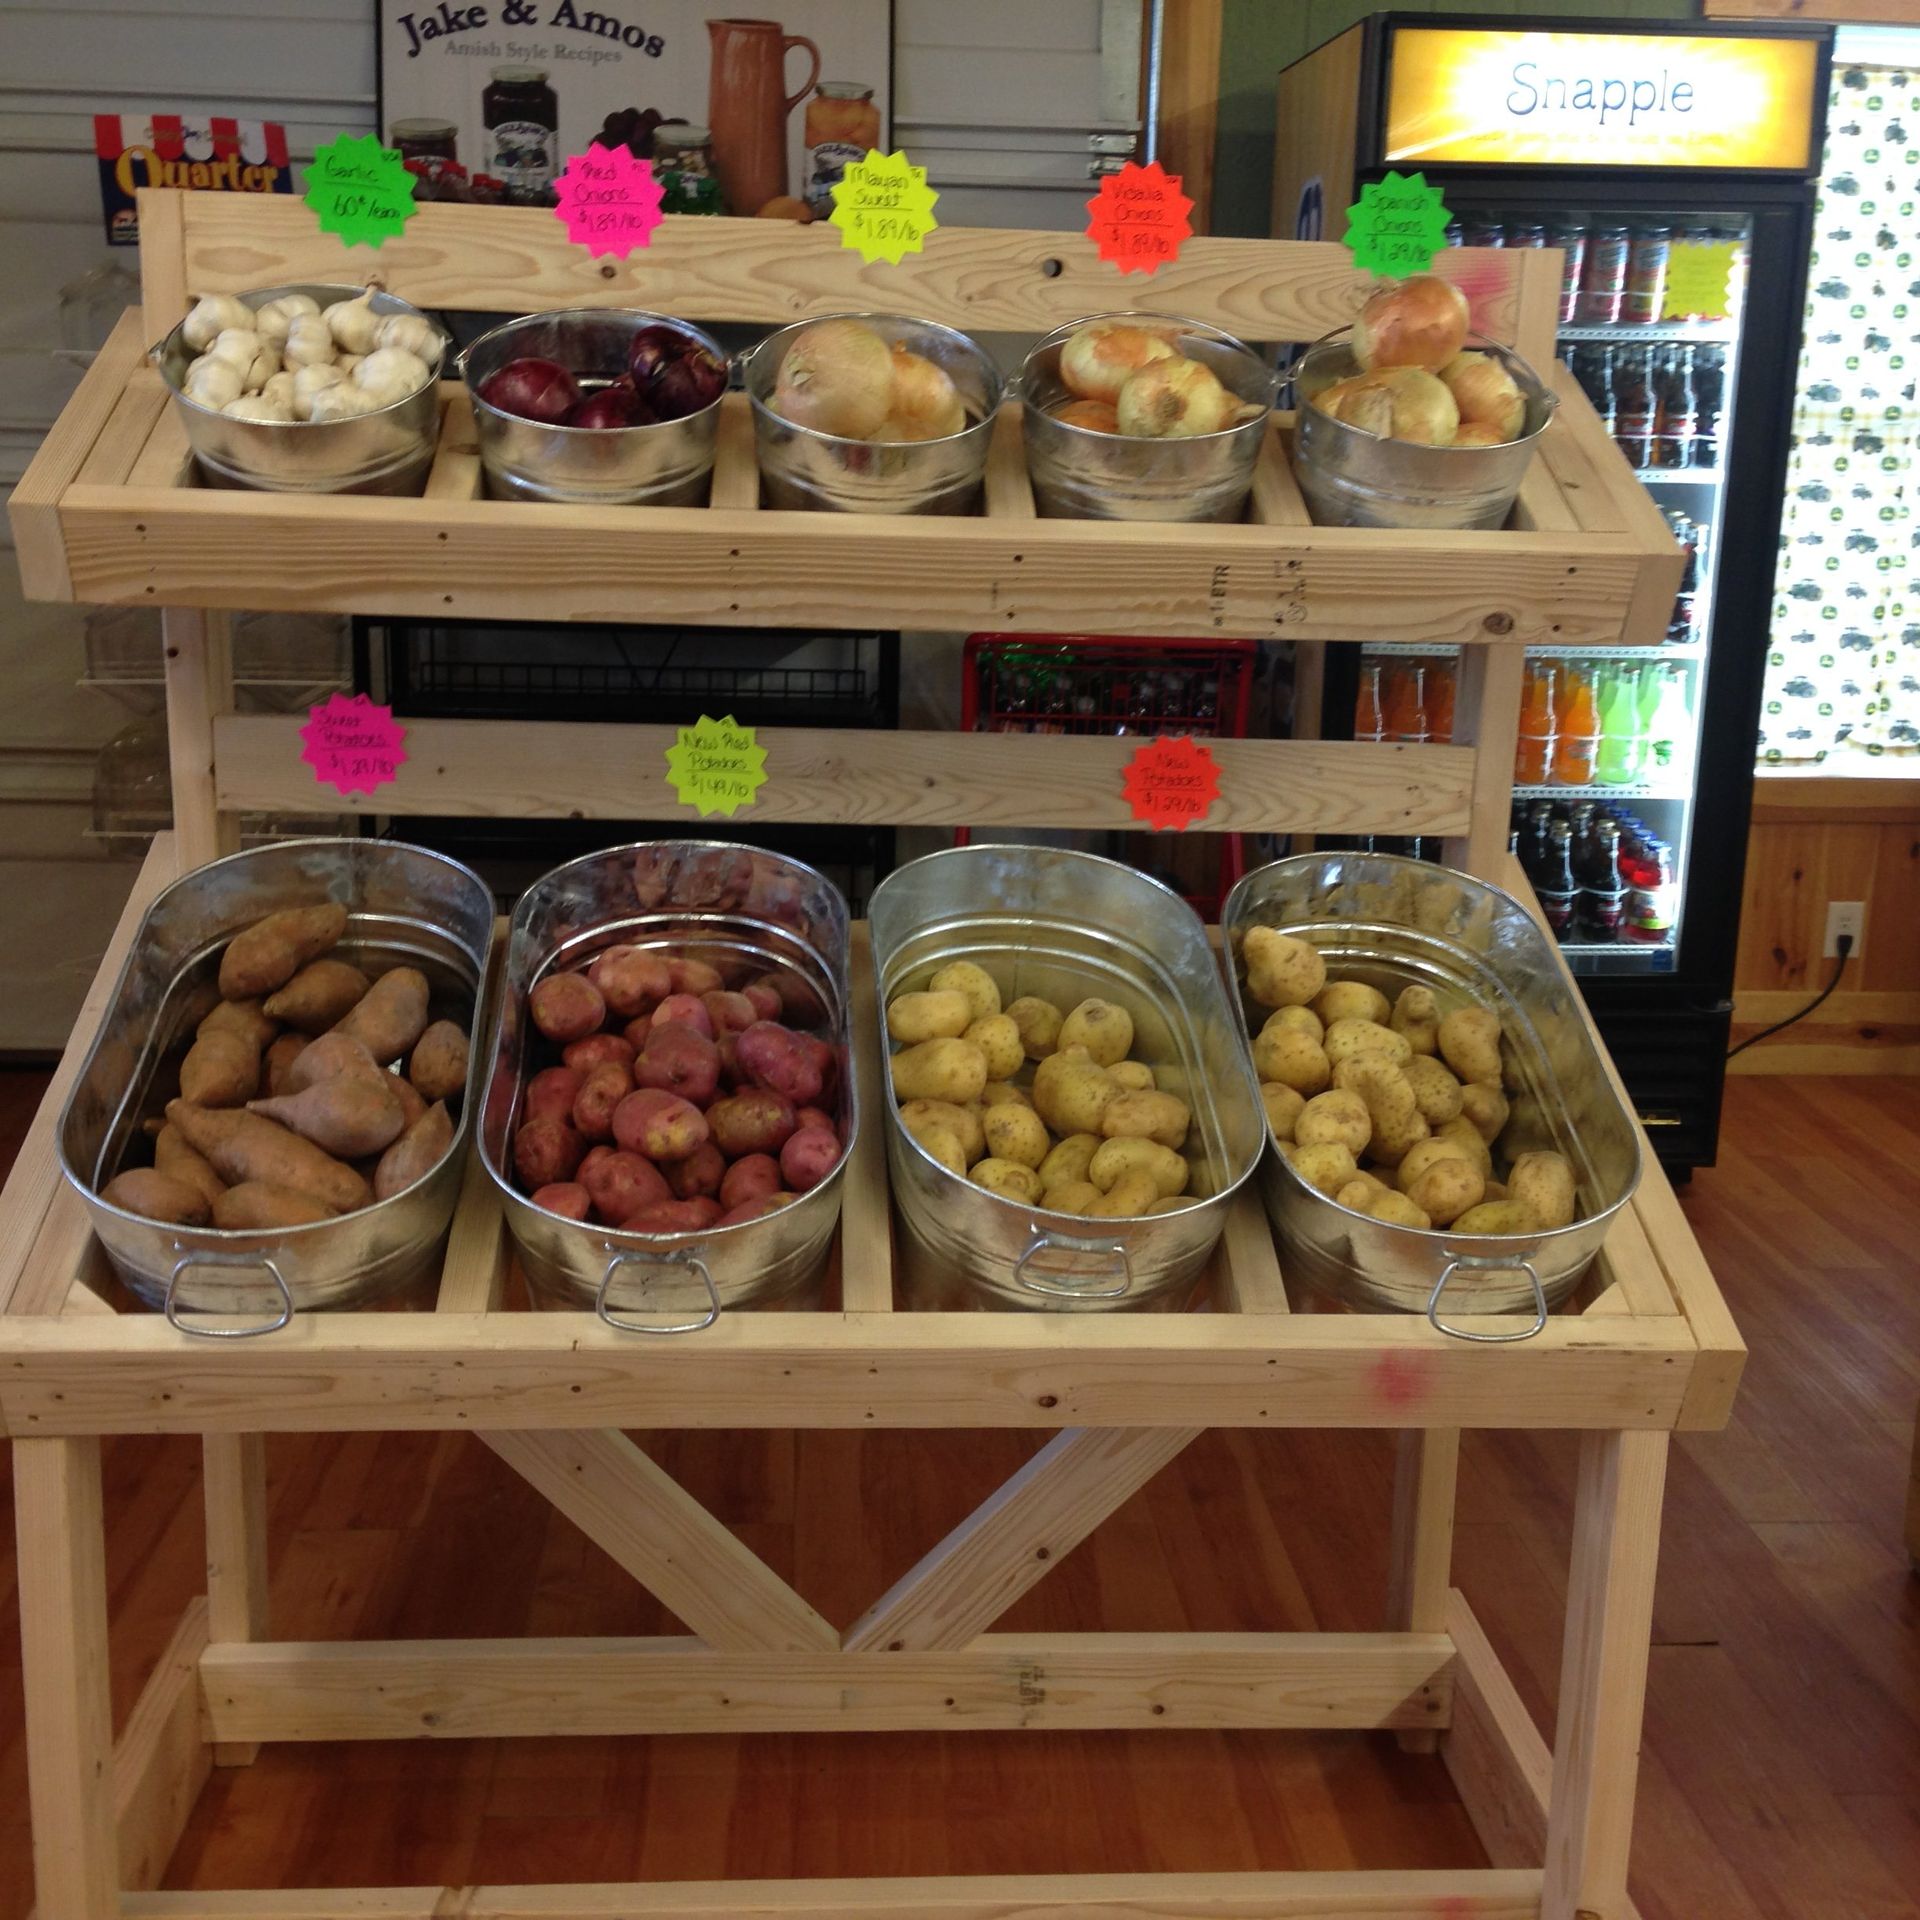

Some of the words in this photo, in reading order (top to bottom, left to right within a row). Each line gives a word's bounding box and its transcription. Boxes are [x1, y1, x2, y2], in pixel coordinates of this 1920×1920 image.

[398, 1, 489, 58] Jake
[501, 0, 538, 25] &
[549, 0, 666, 58] Amos
[445, 40, 501, 58] Amish
[506, 41, 549, 63] Style
[554, 43, 623, 66] Recipes
[1506, 62, 1694, 126] Snapple
[115, 145, 279, 198] Quarter
[325, 154, 379, 182] Garlic
[580, 161, 618, 181] Red
[849, 166, 909, 192] Mayan
[574, 183, 629, 204] Onions
[854, 187, 903, 206] Sweet
[1367, 188, 1429, 213] Spanish
[1373, 215, 1424, 233] Onions
[687, 750, 748, 771] Potatoes
